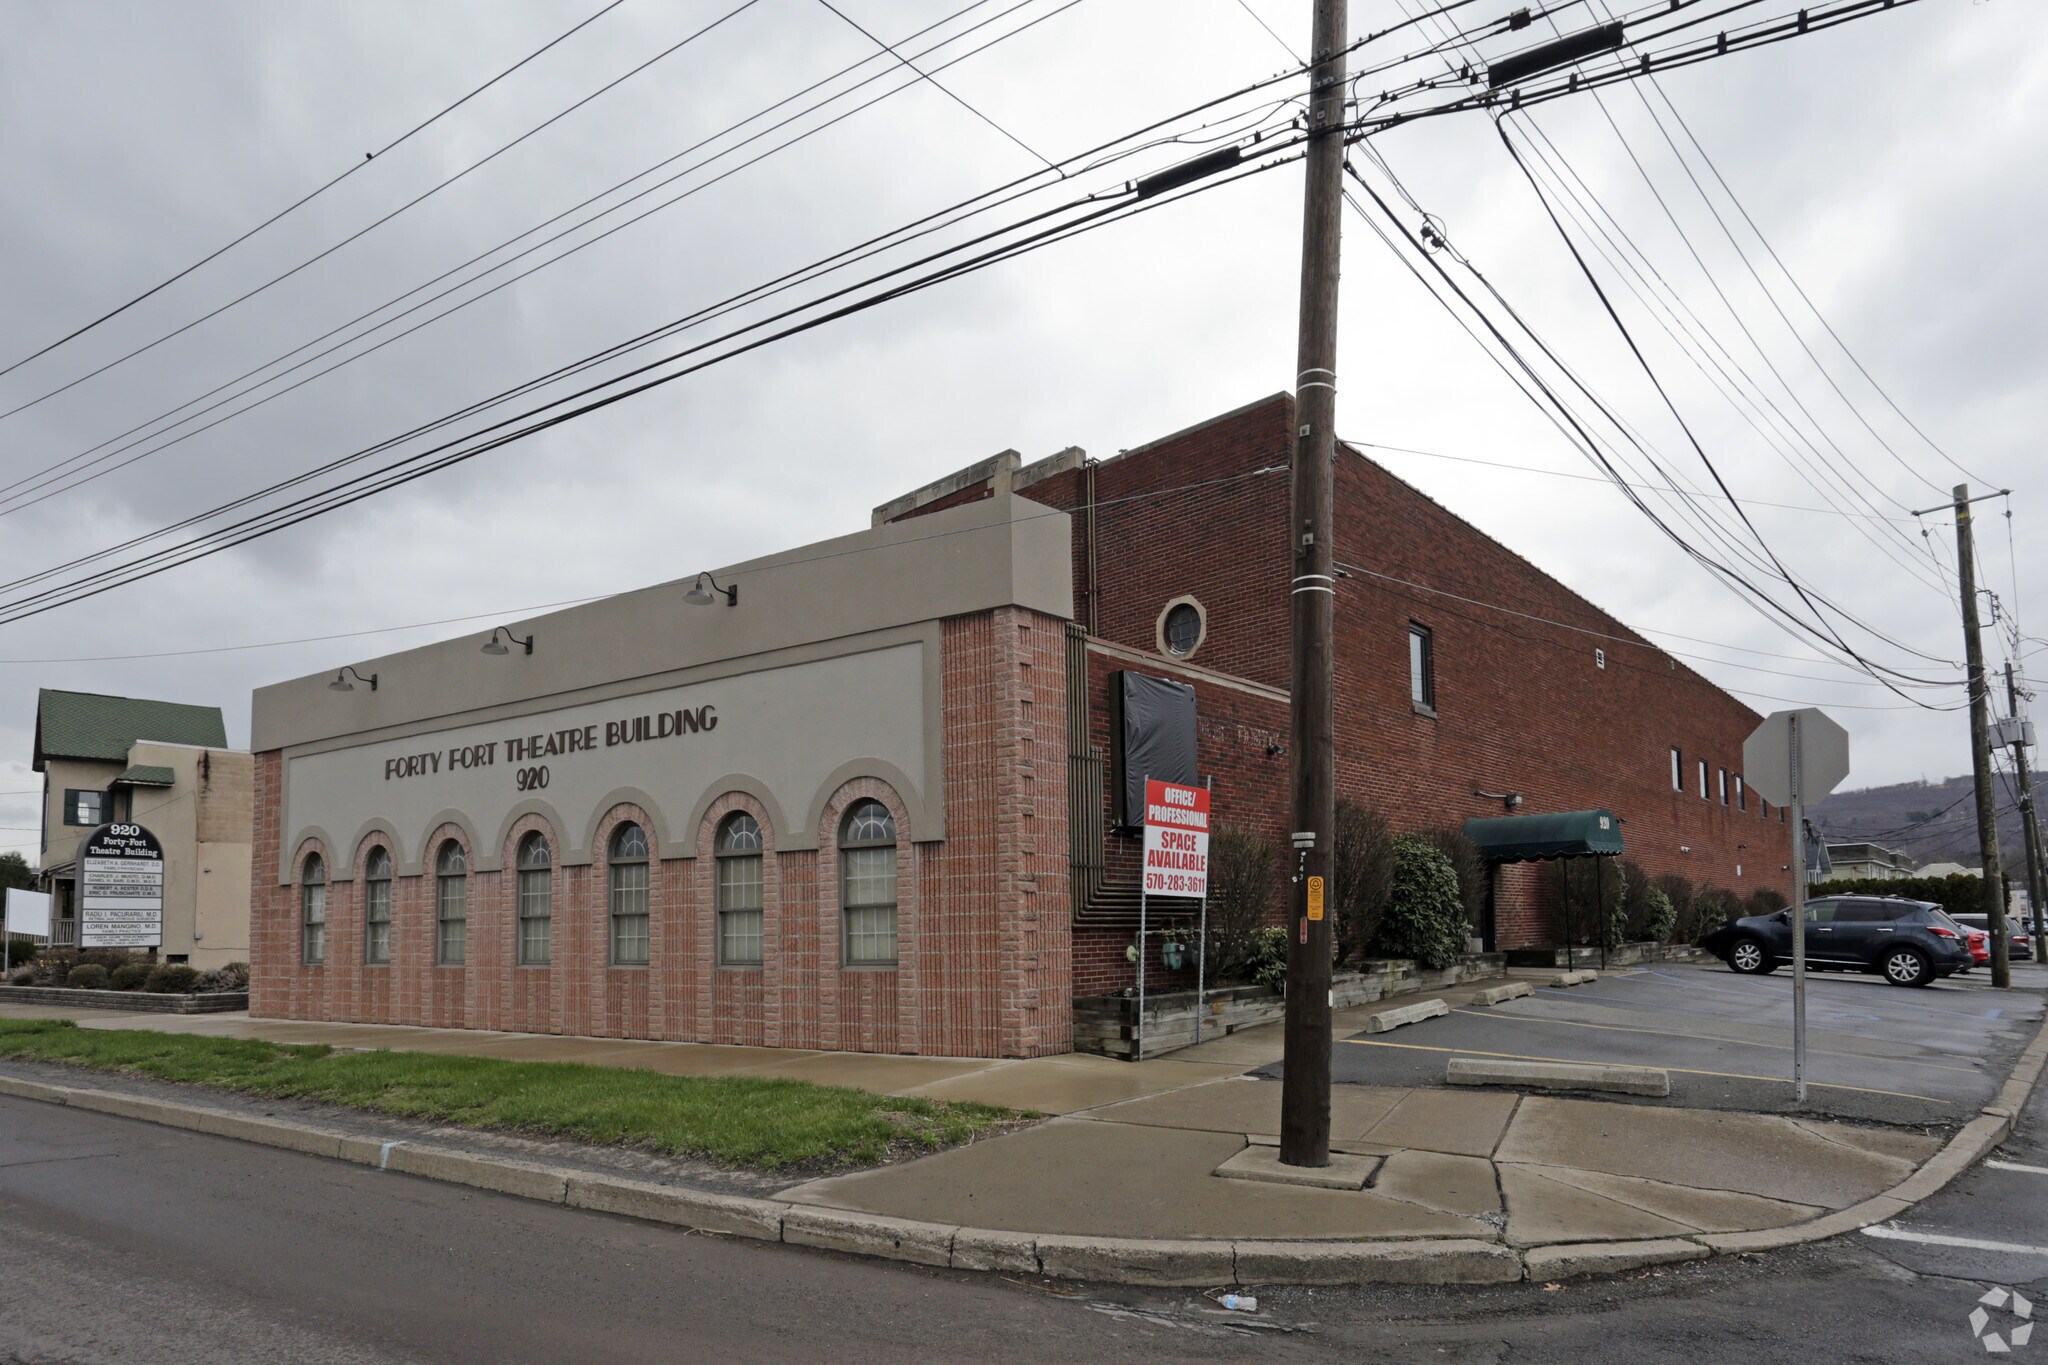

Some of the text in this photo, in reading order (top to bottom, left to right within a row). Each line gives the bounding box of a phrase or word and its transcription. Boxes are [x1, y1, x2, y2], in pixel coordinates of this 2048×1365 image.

[385, 705, 718, 780] FORTY FORT THEATRE BUILDING
[516, 766, 550, 791] 920
[1164, 787, 1196, 807] OFFICE/
[1148, 804, 1208, 828] PROFESSIONAL
[110, 824, 140, 836] 920
[103, 837, 146, 846] Forty-Fort
[1161, 831, 1196, 852] SPACE
[90, 846, 158, 858] Theatre Building
[1147, 850, 1205, 872] AVAILABLE
[1146, 873, 1205, 893] 570-283-3611
